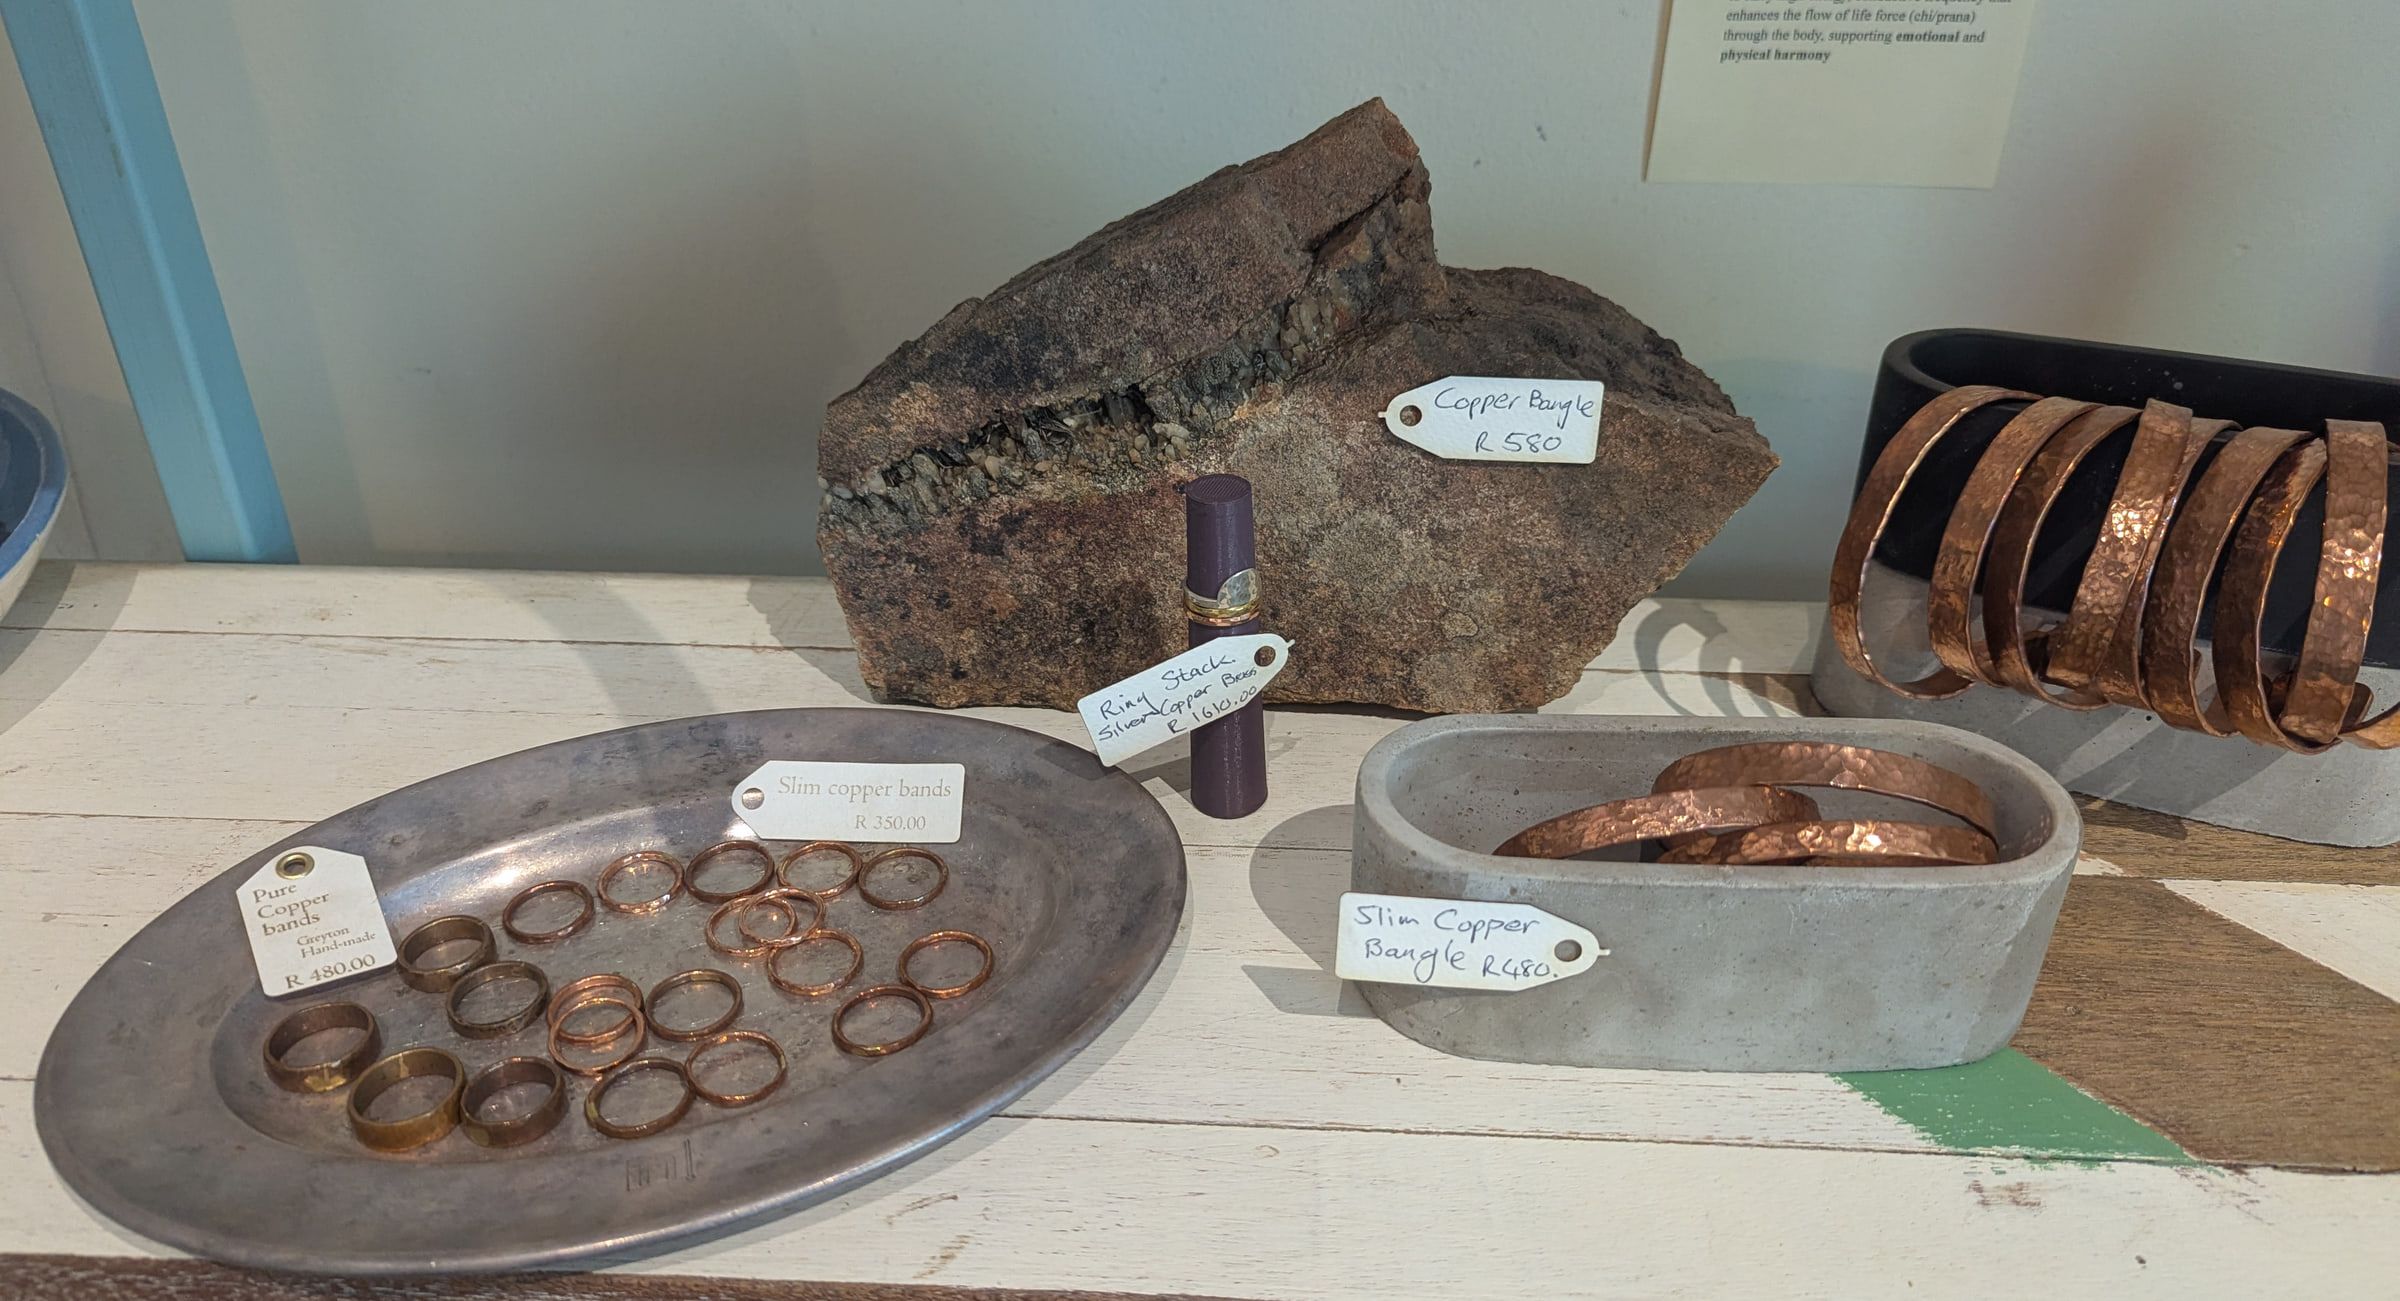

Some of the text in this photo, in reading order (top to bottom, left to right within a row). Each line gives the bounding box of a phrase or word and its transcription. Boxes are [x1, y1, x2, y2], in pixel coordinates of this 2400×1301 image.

[1726, 9, 1976, 25] enhances the flow of life force (chi/prana)
[1723, 29, 1985, 44] through the body, supporting emotional and
[1719, 49, 1831, 64] physical harmony
[1434, 387, 1594, 429] Copper Bangle
[1475, 431, 1562, 453] R 580
[1100, 691, 1159, 720] Ring
[1160, 684, 1212, 716] Copper
[1167, 718, 1187, 734] R
[778, 776, 952, 804] Slim copper bands
[855, 815, 926, 831] R 350.00
[252, 884, 297, 903] Pure
[257, 893, 330, 919] Copper
[262, 911, 320, 936] bands
[1354, 905, 1540, 943] Slim Copper
[296, 927, 350, 947] Greyton
[300, 931, 376, 959] Hand-made
[284, 953, 376, 989] R 480.00
[1365, 938, 1466, 984] Bangle
